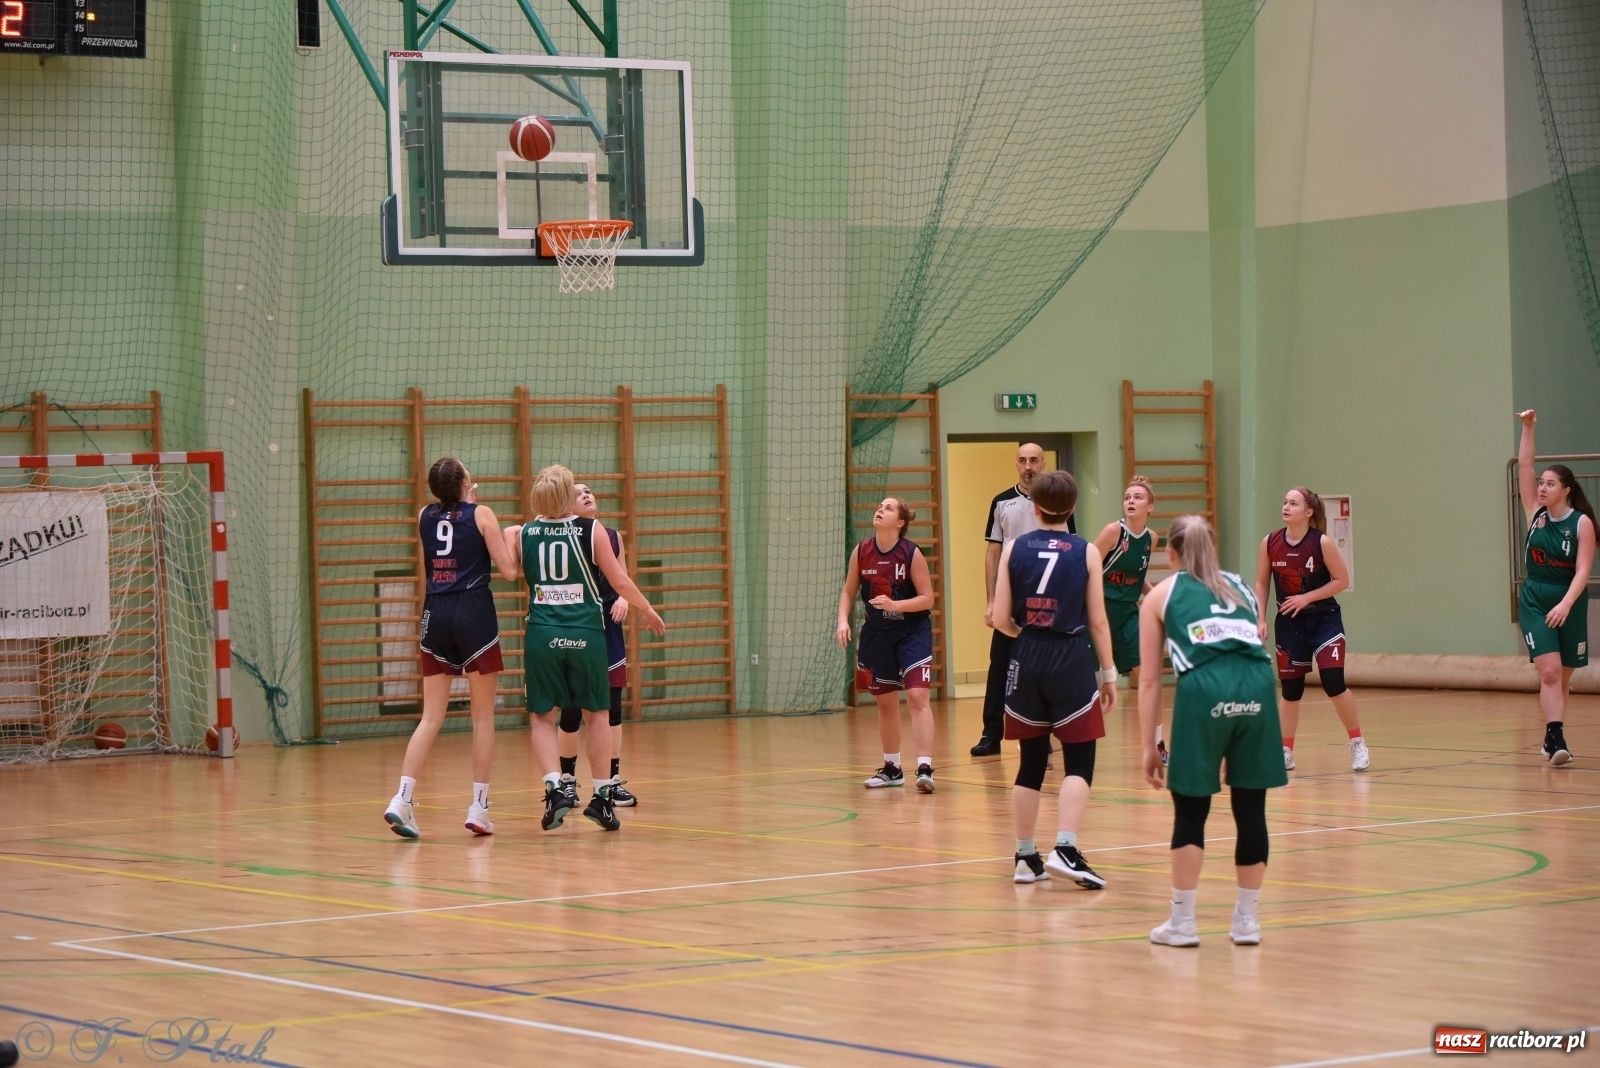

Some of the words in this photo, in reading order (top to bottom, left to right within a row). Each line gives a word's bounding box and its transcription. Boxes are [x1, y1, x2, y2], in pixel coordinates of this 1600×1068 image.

[1, 1, 24, 36] 2
[74, 11, 85, 20] 14
[74, 23, 85, 32] 15
[4, 41, 55, 50] www.3d.com.pl
[81, 37, 138, 48] PRZEWINIENIA
[436, 520, 454, 556] 9
[1561, 540, 1571, 557] 4
[538, 541, 569, 582] 10
[1305, 556, 1314, 573] 4
[895, 563, 906, 580] 14
[1036, 551, 1060, 595] 7
[558, 637, 587, 648] Clavis
[1525, 632, 1536, 650] 4
[1331, 646, 1340, 661] 4
[922, 667, 931, 682] 14
[1223, 700, 1262, 714] Clavis
